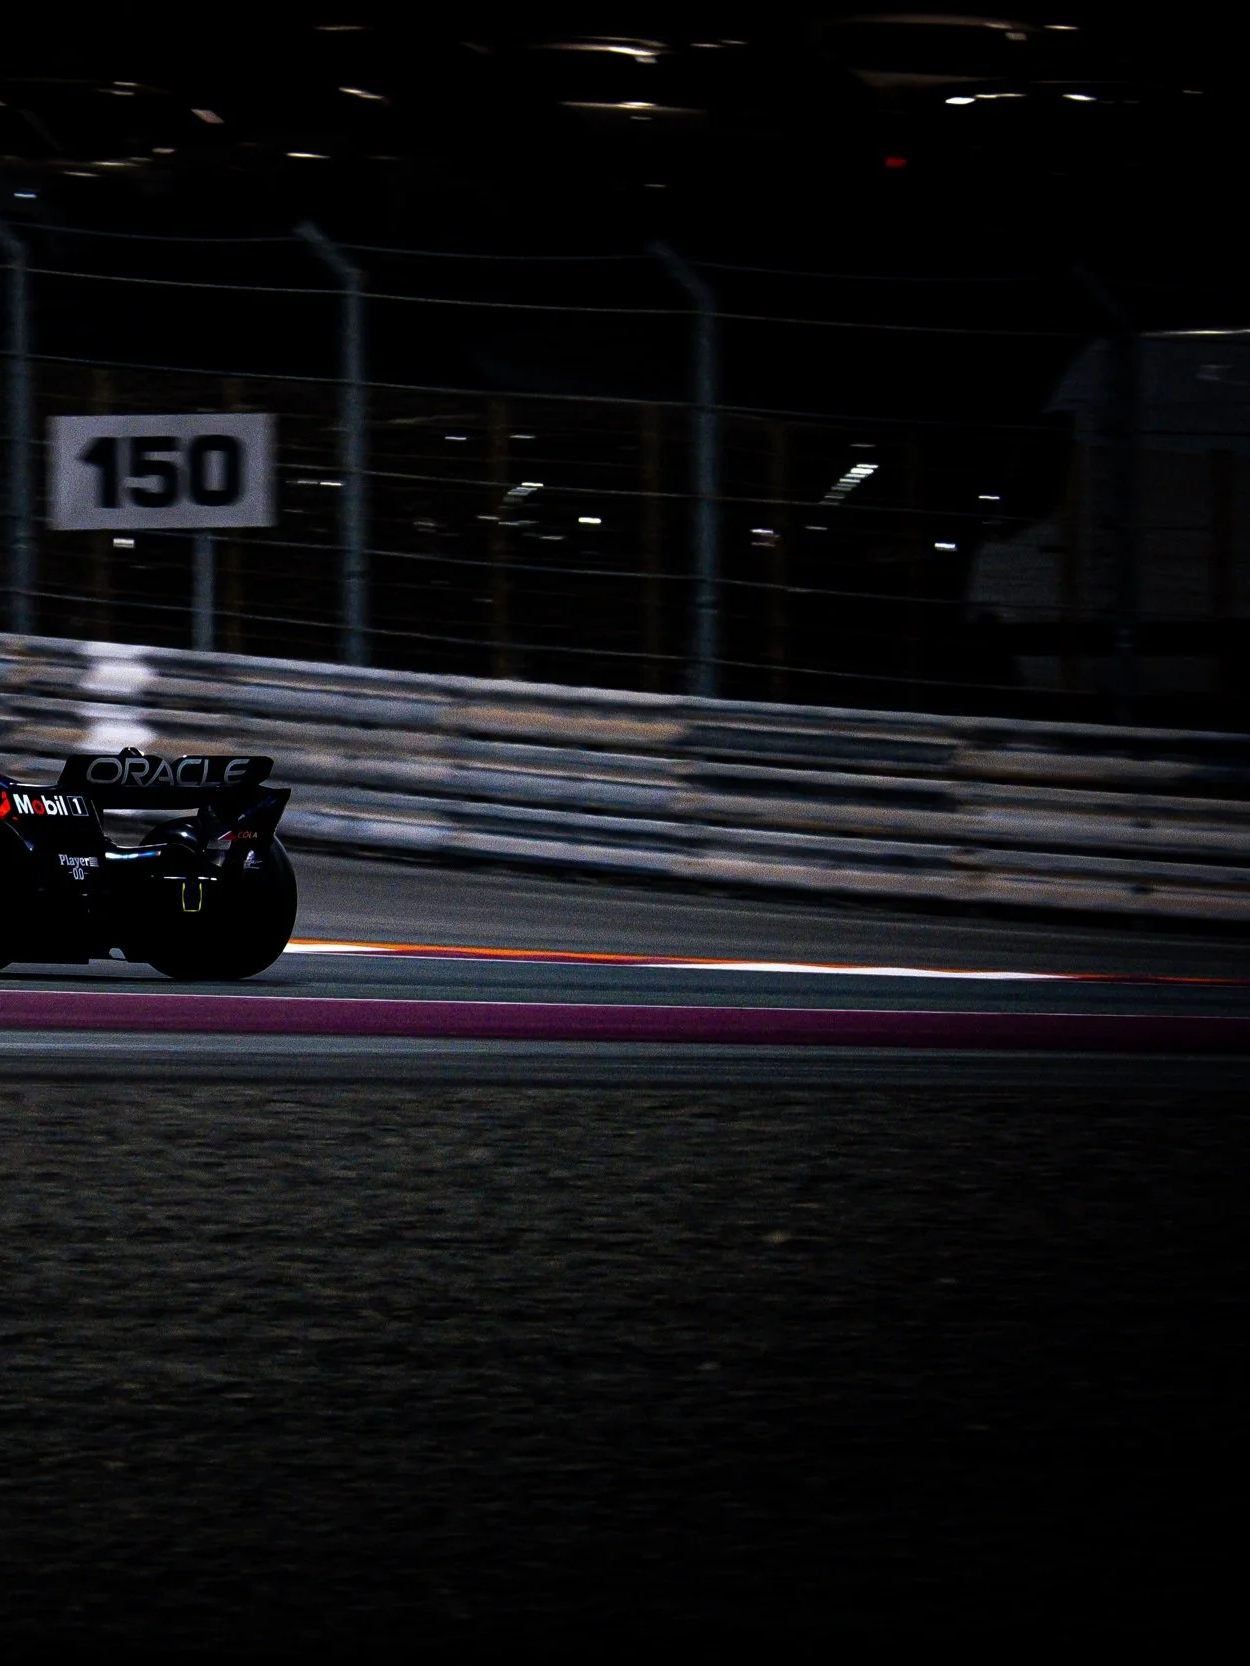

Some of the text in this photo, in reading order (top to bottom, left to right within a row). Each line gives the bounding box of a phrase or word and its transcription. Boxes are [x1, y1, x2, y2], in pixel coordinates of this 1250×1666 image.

[80, 436, 238, 509] 150
[86, 757, 250, 786] ORACLE
[13, 794, 68, 816] Mobil
